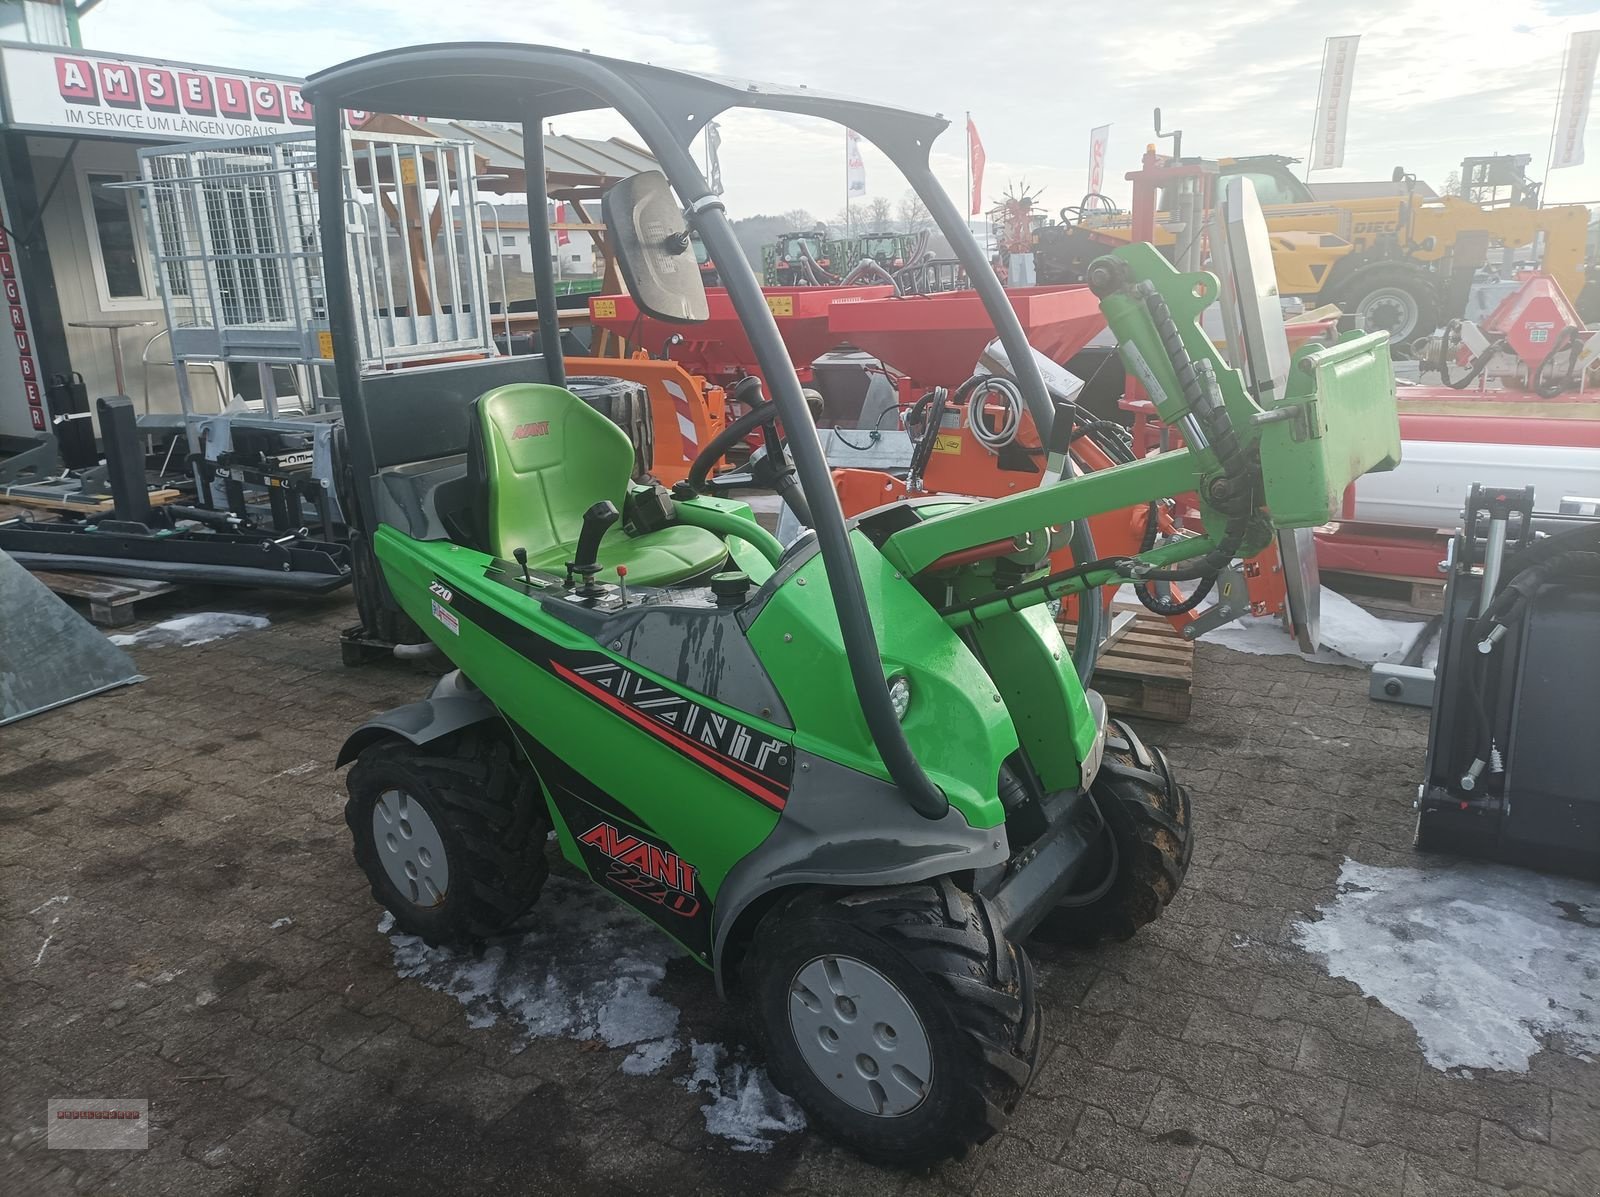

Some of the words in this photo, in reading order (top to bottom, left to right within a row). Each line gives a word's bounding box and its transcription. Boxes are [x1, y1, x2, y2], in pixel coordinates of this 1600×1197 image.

[64, 62, 365, 119] AMSELGR
[65, 109, 84, 124] IM
[87, 111, 144, 129] SERVICE
[147, 117, 170, 131] UM
[172, 117, 225, 136] LÄNGEN
[511, 420, 550, 440] AVANT
[429, 580, 453, 602] 220
[577, 821, 696, 897] AVANT
[605, 862, 700, 918] 220
